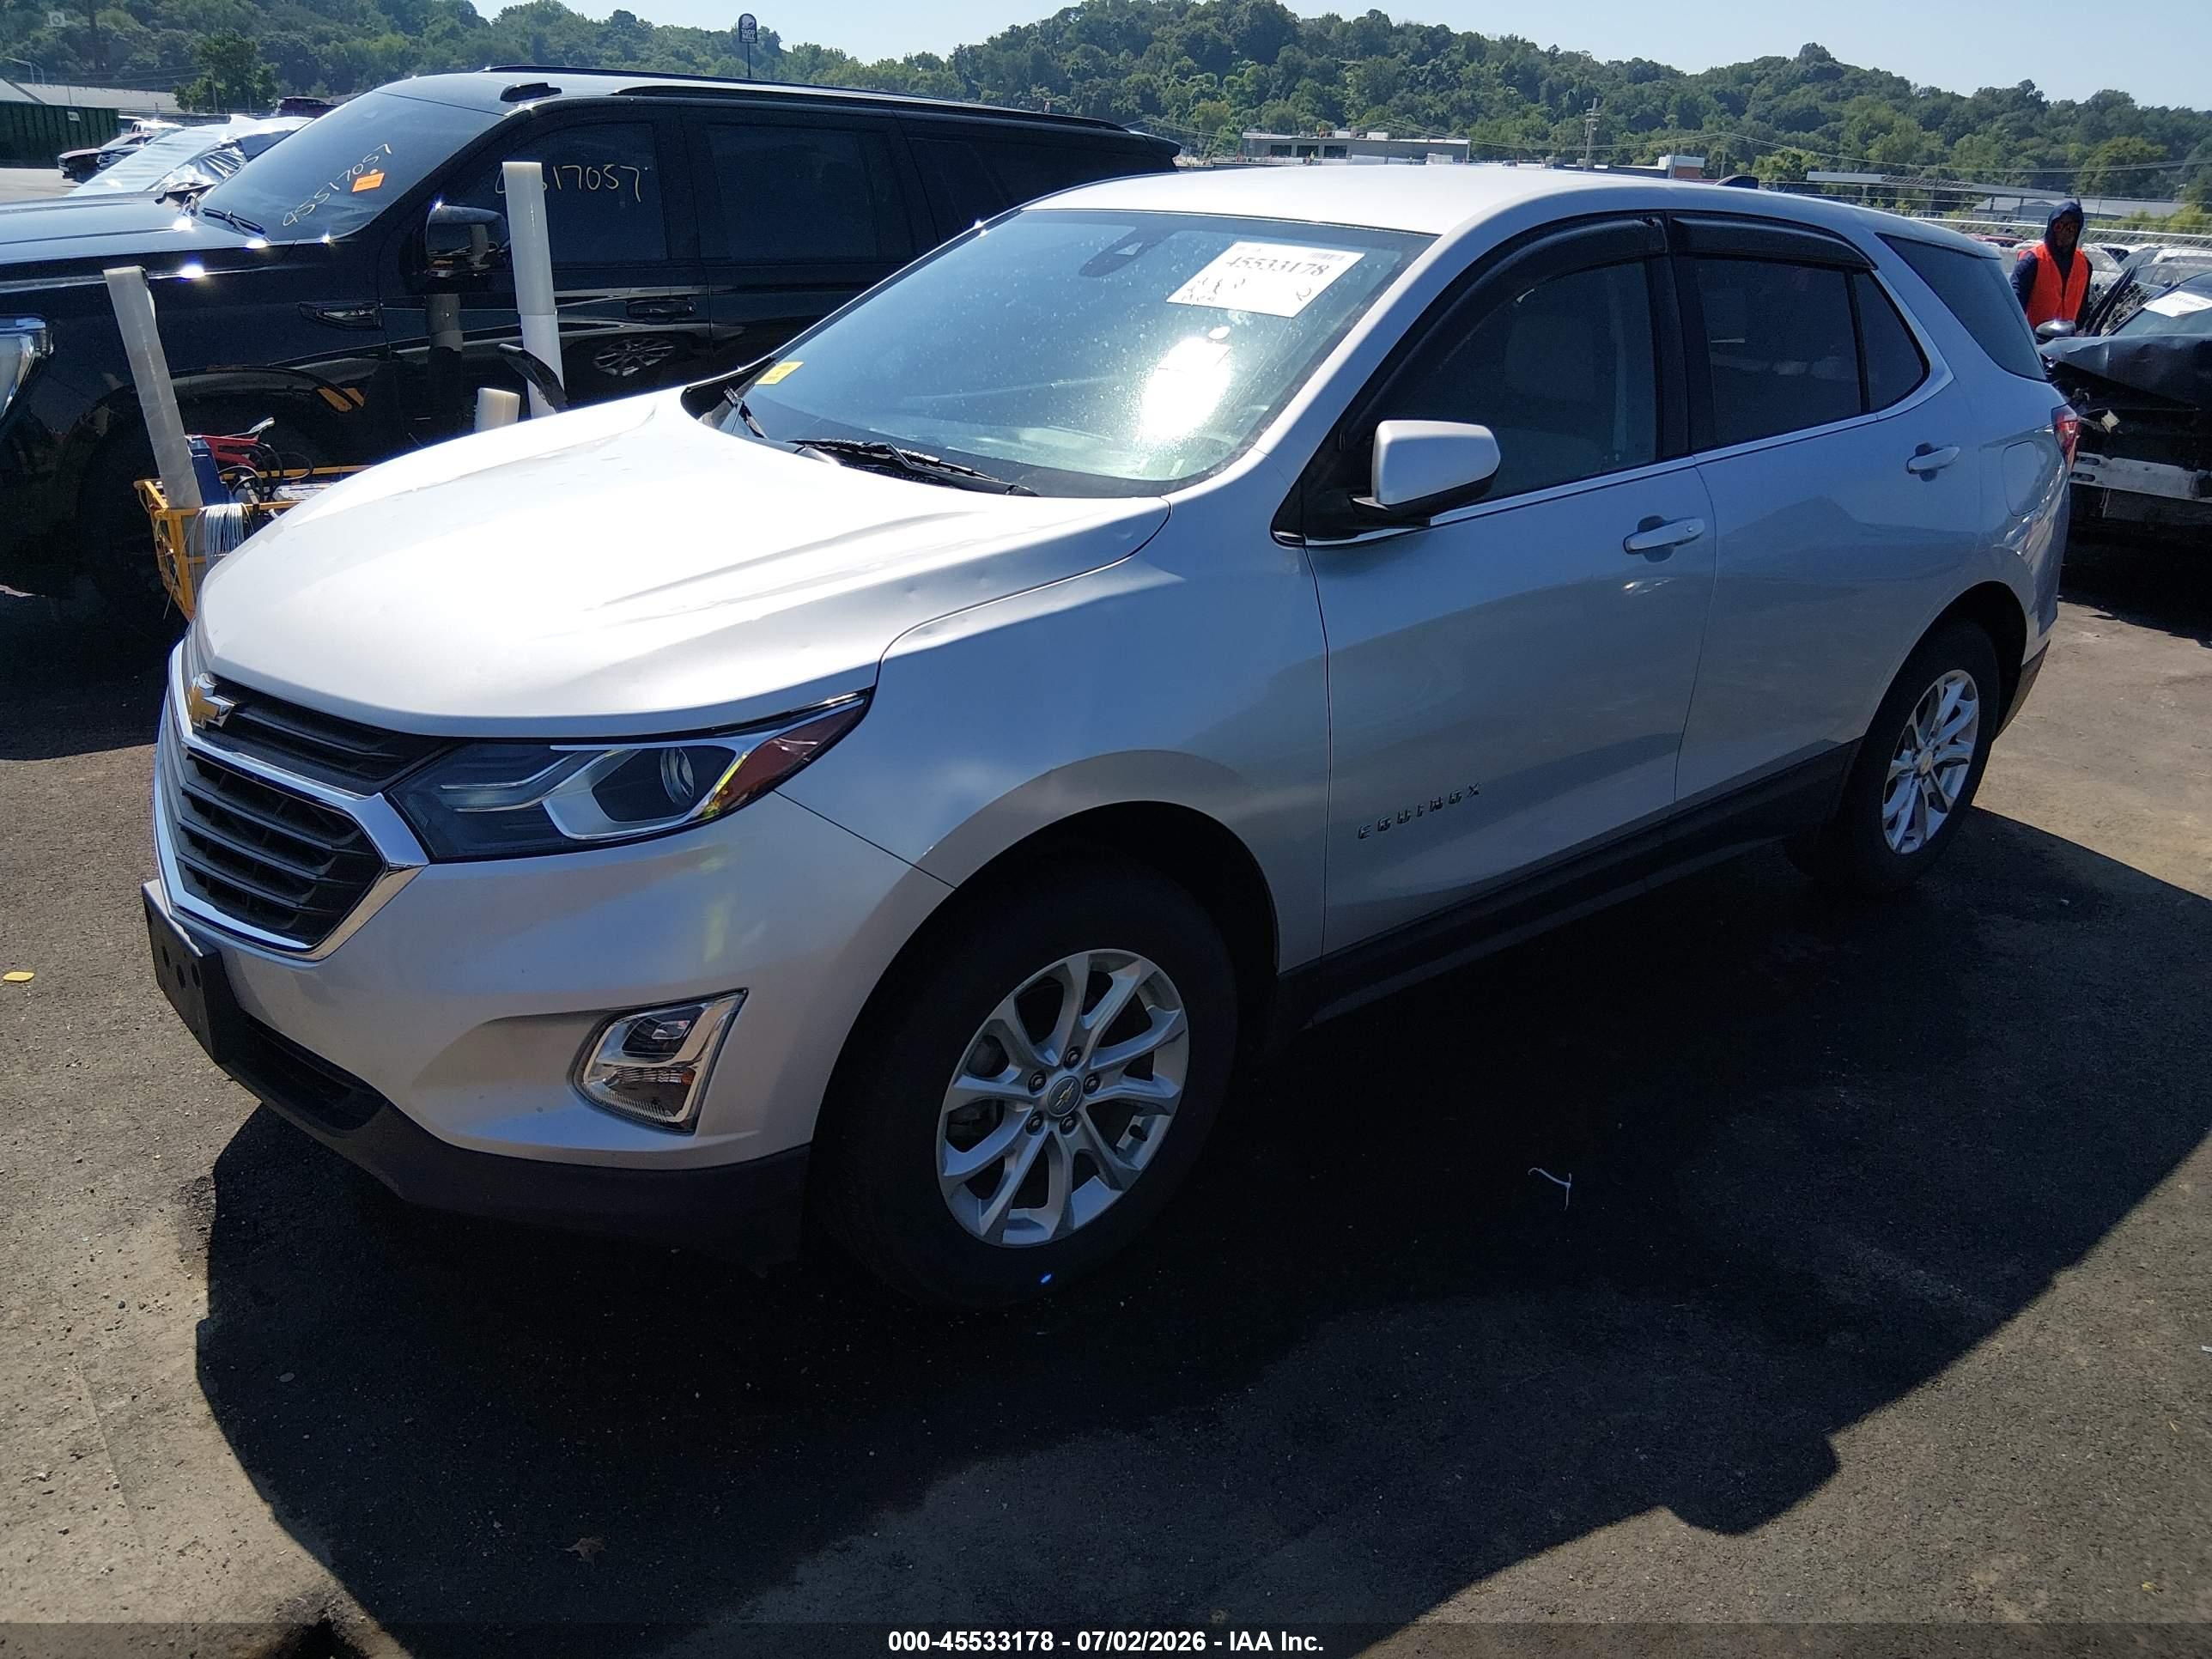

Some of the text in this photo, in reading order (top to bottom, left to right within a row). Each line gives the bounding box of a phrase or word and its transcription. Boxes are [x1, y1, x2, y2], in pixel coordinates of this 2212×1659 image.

[283, 143, 392, 226] 45517057
[495, 164, 641, 203] 17057
[1226, 256, 1330, 276] 45533178
[1358, 782, 1480, 840] EQUINOX
